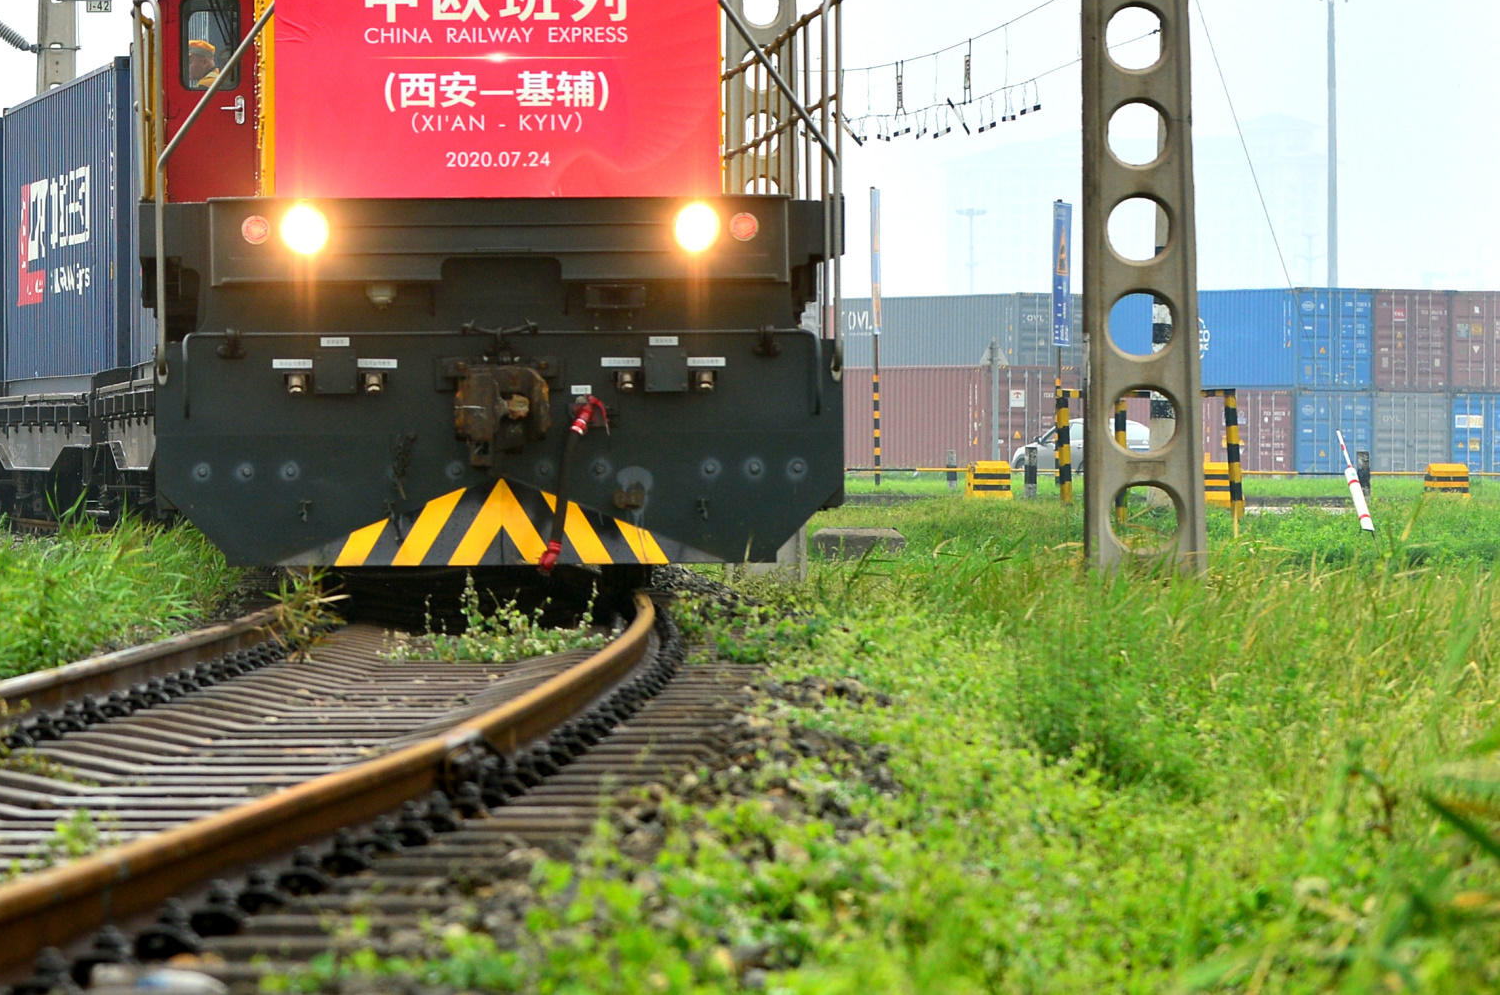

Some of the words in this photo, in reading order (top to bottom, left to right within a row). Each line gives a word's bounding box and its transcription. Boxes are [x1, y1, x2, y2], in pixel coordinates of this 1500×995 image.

[364, 28, 433, 44] CHINA
[446, 27, 534, 43] RAILWAY
[548, 27, 628, 43] EXPRESS
[519, 112, 582, 133] KYIV)
[446, 152, 551, 168] 2020.07.24
